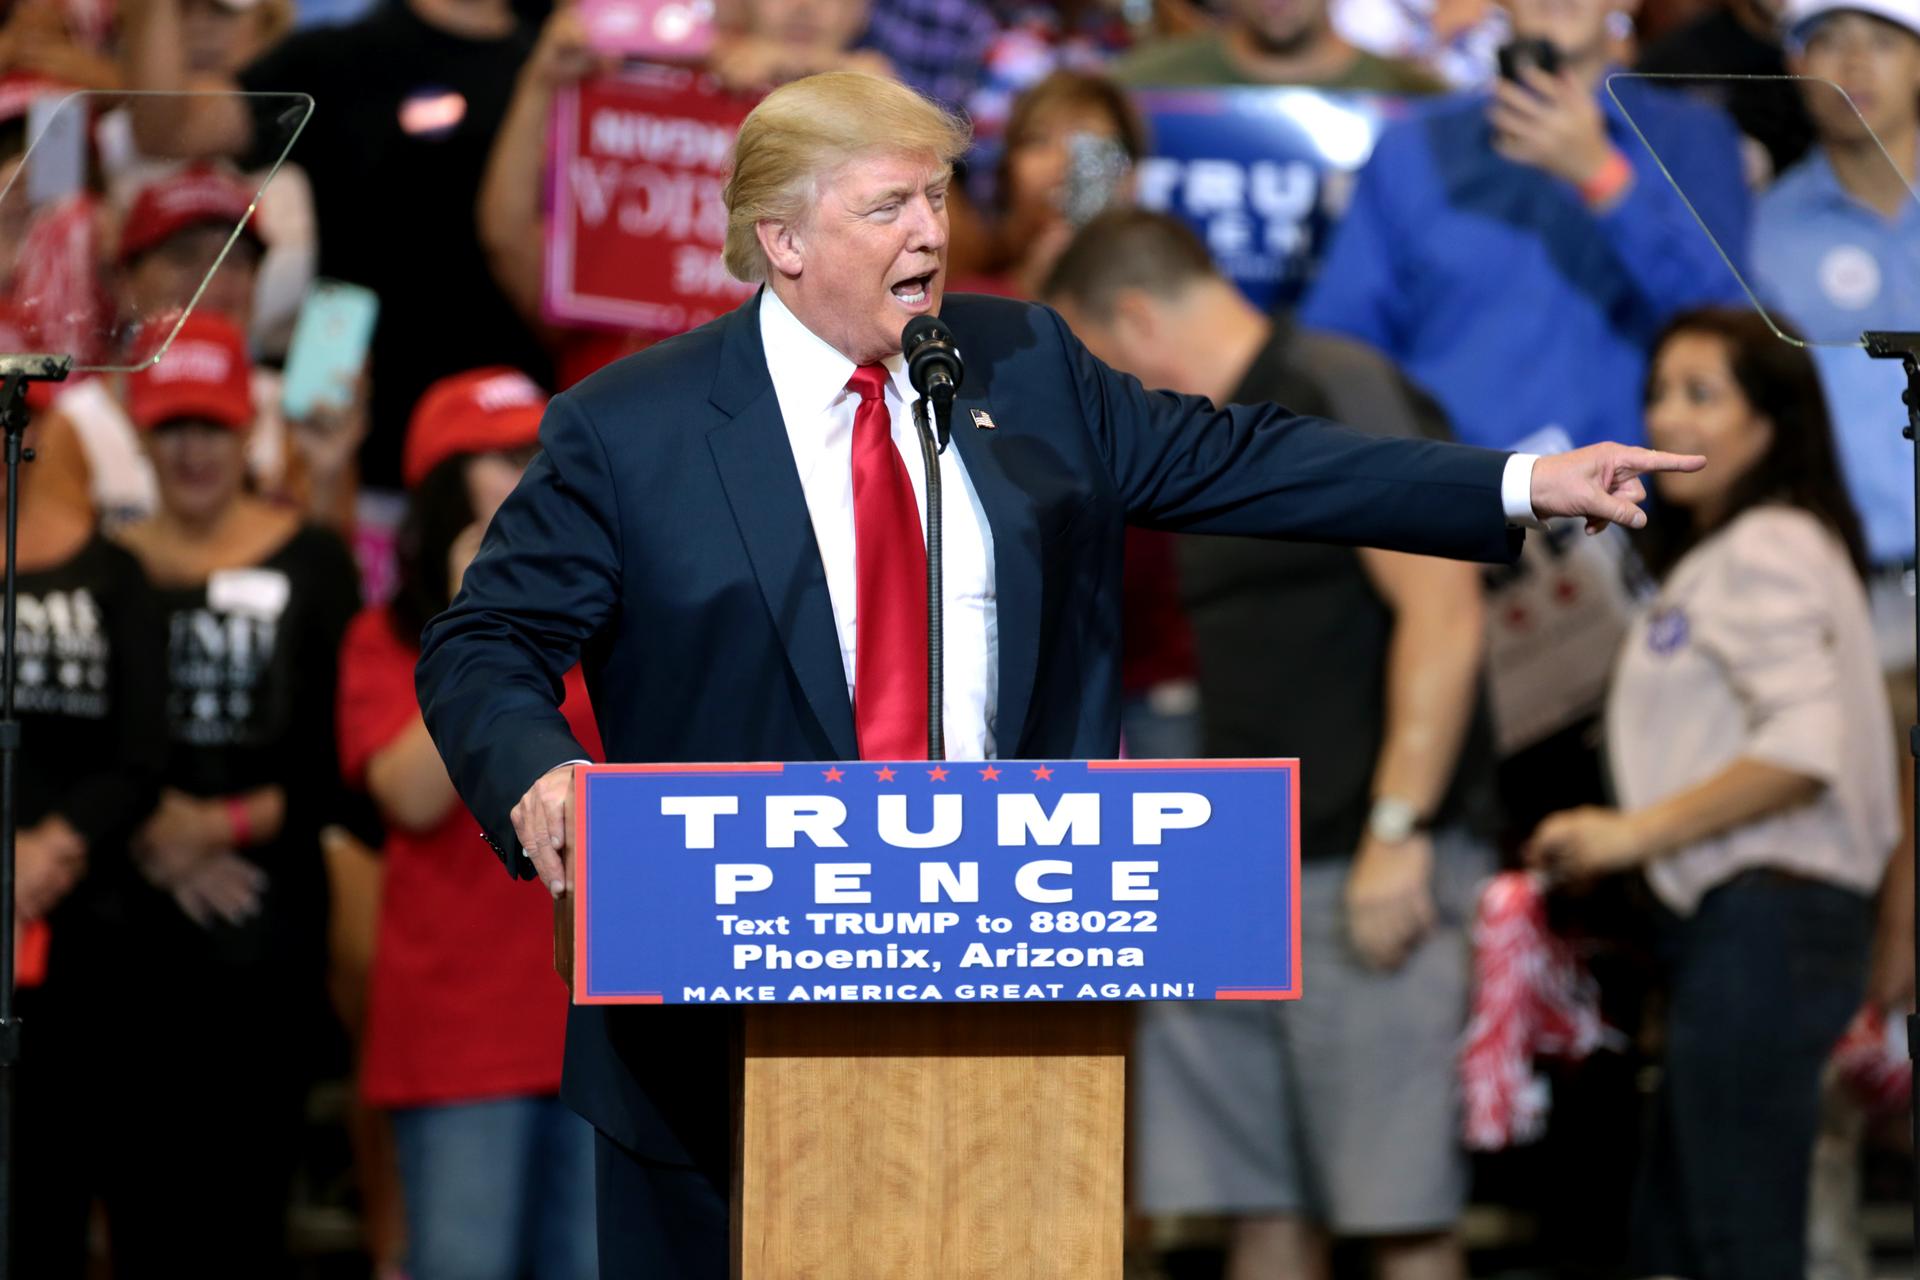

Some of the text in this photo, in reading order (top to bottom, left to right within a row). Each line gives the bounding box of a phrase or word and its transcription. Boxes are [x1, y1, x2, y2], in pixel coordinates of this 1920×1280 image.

[1136, 158, 1318, 220] TRU
[660, 791, 1212, 849] TRUMP
[714, 859, 1159, 905] PENCE
[715, 910, 1158, 935] Text TRUMP to 88022
[733, 942, 1144, 973] Phoenix, Arizona
[683, 983, 1195, 1001] MAKE AMERICA GREAT AGAIN!
